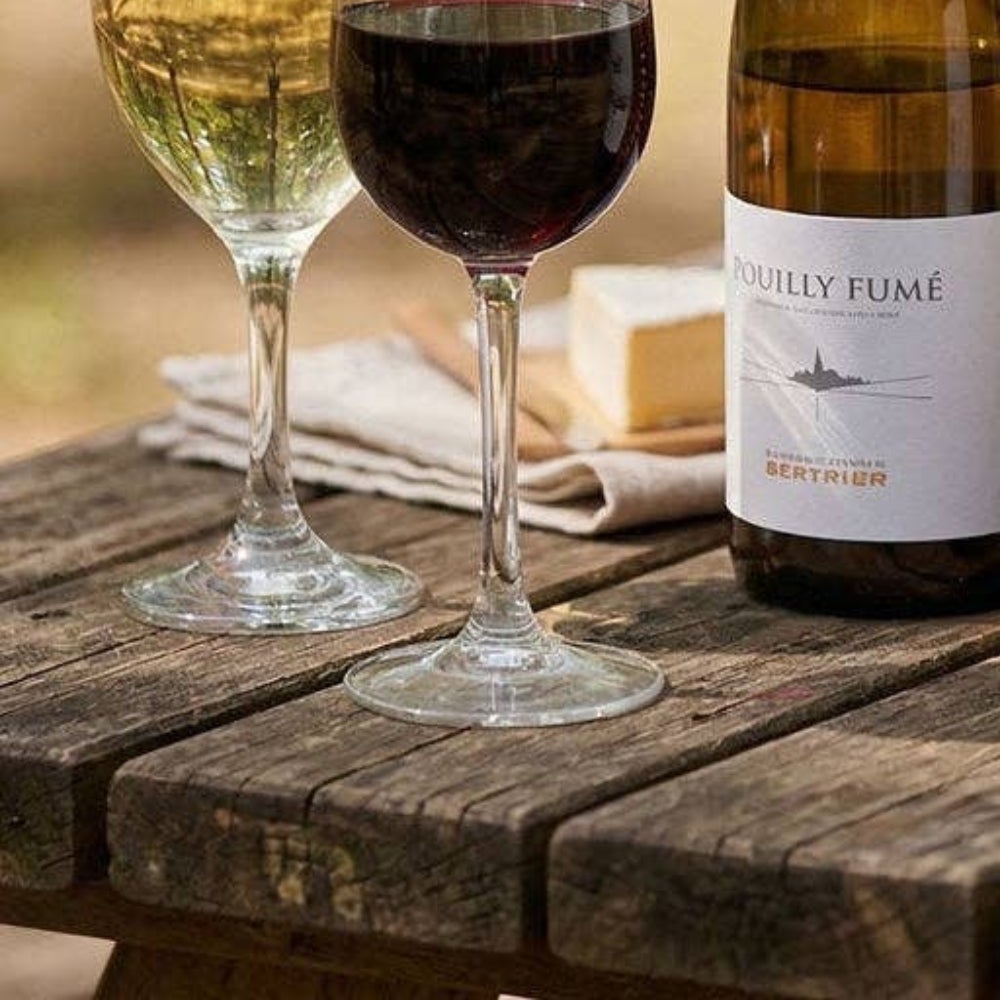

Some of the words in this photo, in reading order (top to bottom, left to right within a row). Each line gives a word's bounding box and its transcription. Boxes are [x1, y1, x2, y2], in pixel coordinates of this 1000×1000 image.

[733, 255, 836, 299] POUILLY
[848, 270, 944, 302] FUMÉ
[765, 459, 888, 488] BERTRIER
